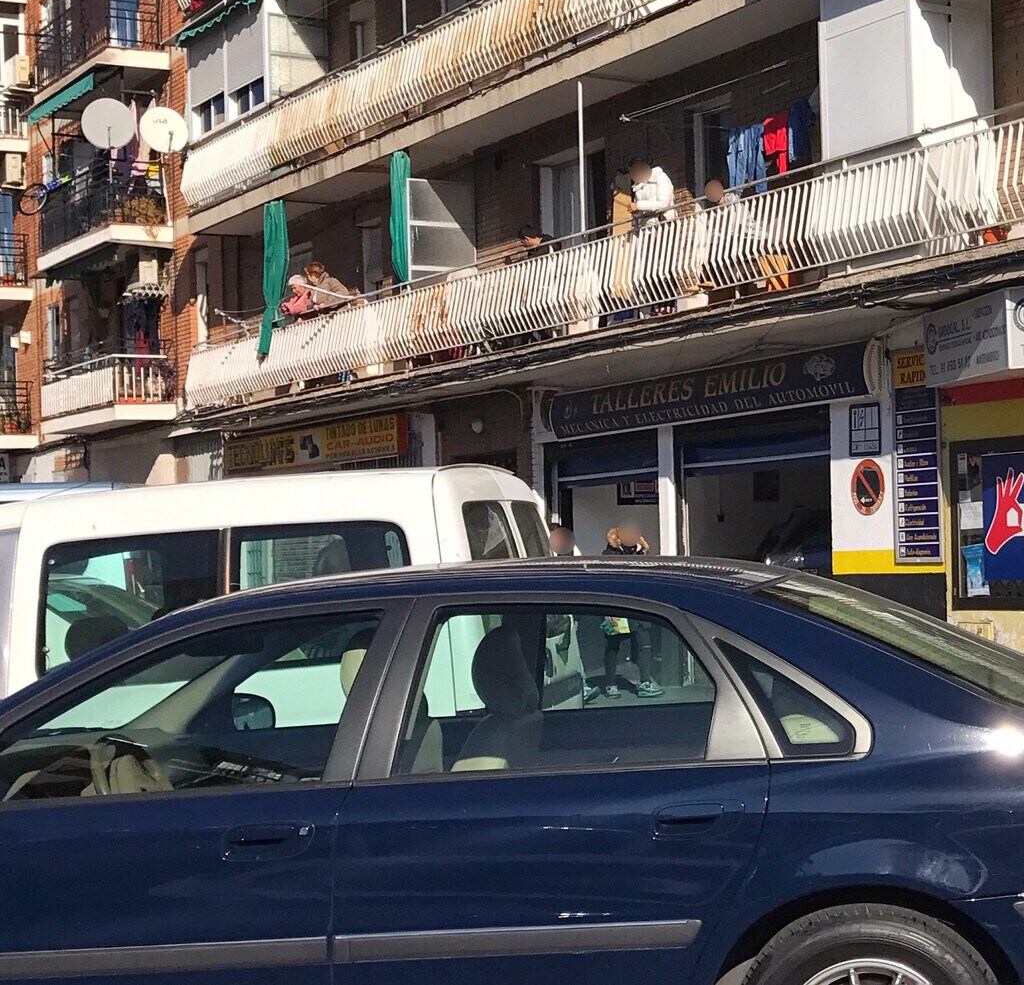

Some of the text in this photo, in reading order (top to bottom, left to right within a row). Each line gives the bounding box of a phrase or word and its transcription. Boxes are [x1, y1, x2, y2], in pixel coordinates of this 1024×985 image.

[897, 354, 925, 369] SERVIC
[900, 370, 926, 384] RAPID
[592, 362, 787, 415] TALLERES EMILIO
[560, 381, 855, 435] MECANICA Y ELECTRICIDAD DEL AUTOMOVIL
[358, 421, 367, 435] DE
[369, 416, 395, 433] LUNAS
[326, 433, 394, 451] CAR-AUDIO
